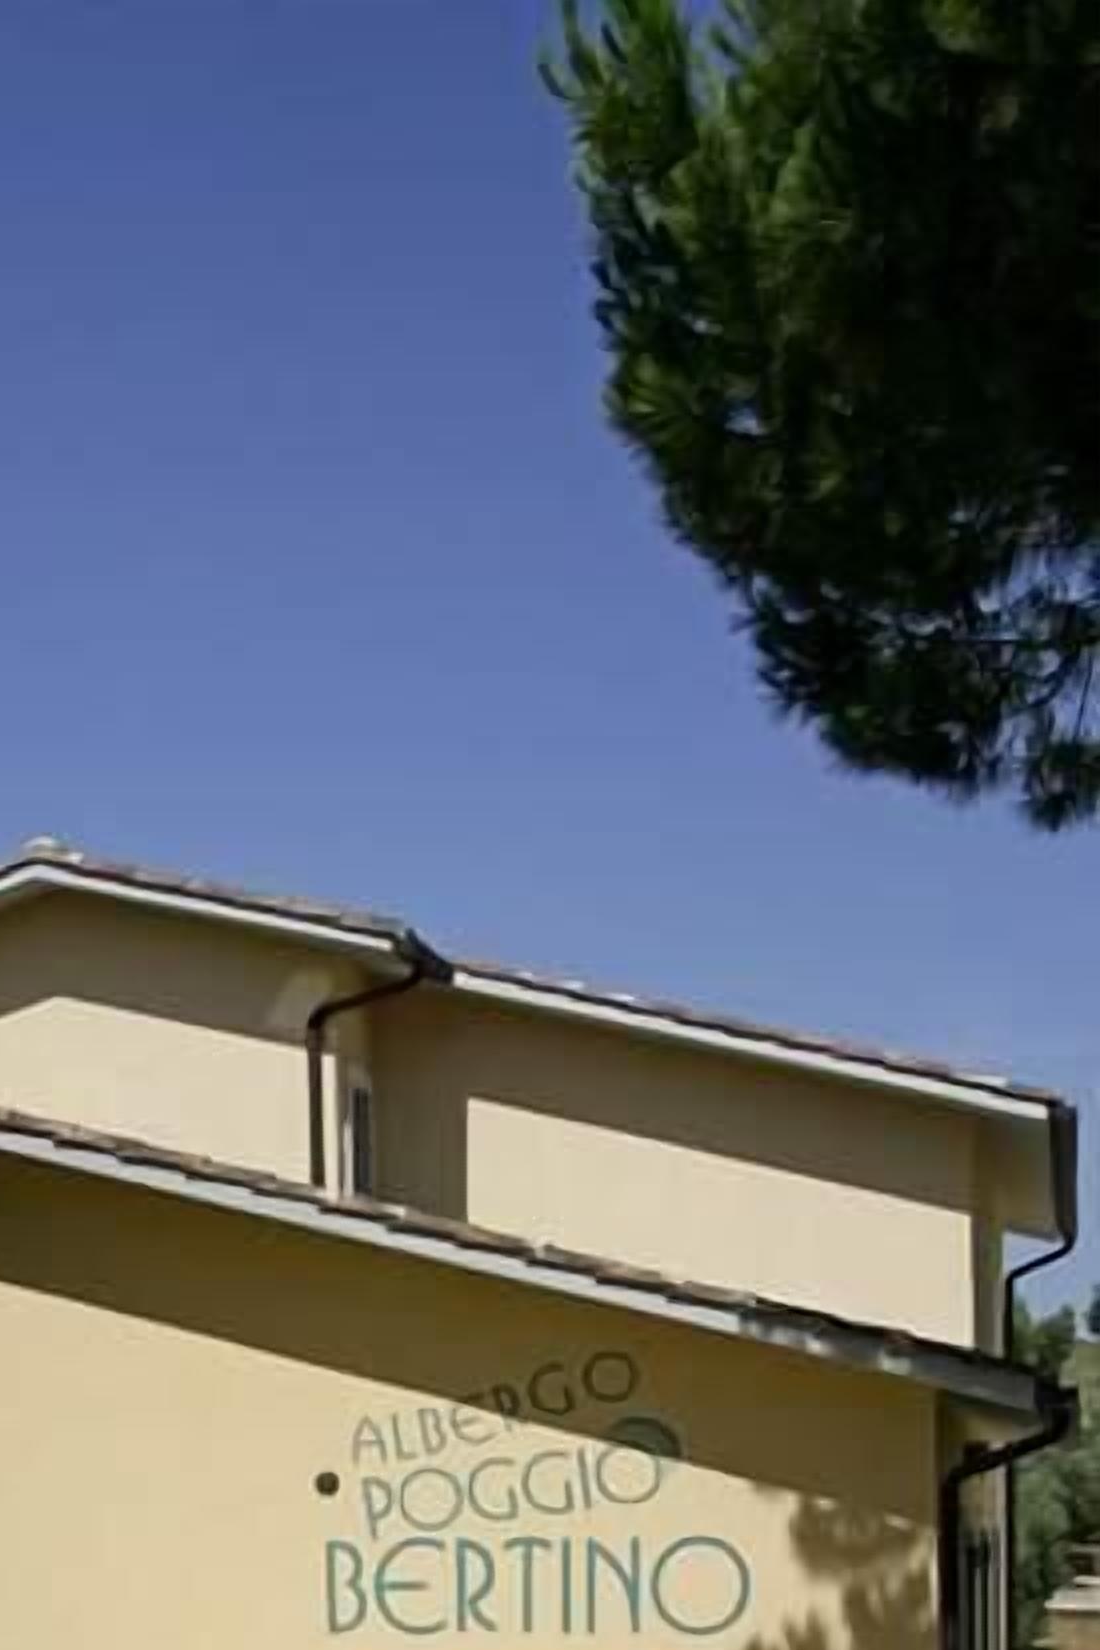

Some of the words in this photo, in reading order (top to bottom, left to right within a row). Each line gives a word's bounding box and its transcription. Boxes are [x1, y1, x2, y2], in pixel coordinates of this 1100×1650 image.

[351, 1350, 640, 1465] ALBERGO
[360, 1436, 664, 1540] POGGIO
[325, 1535, 751, 1636] BERTINO
